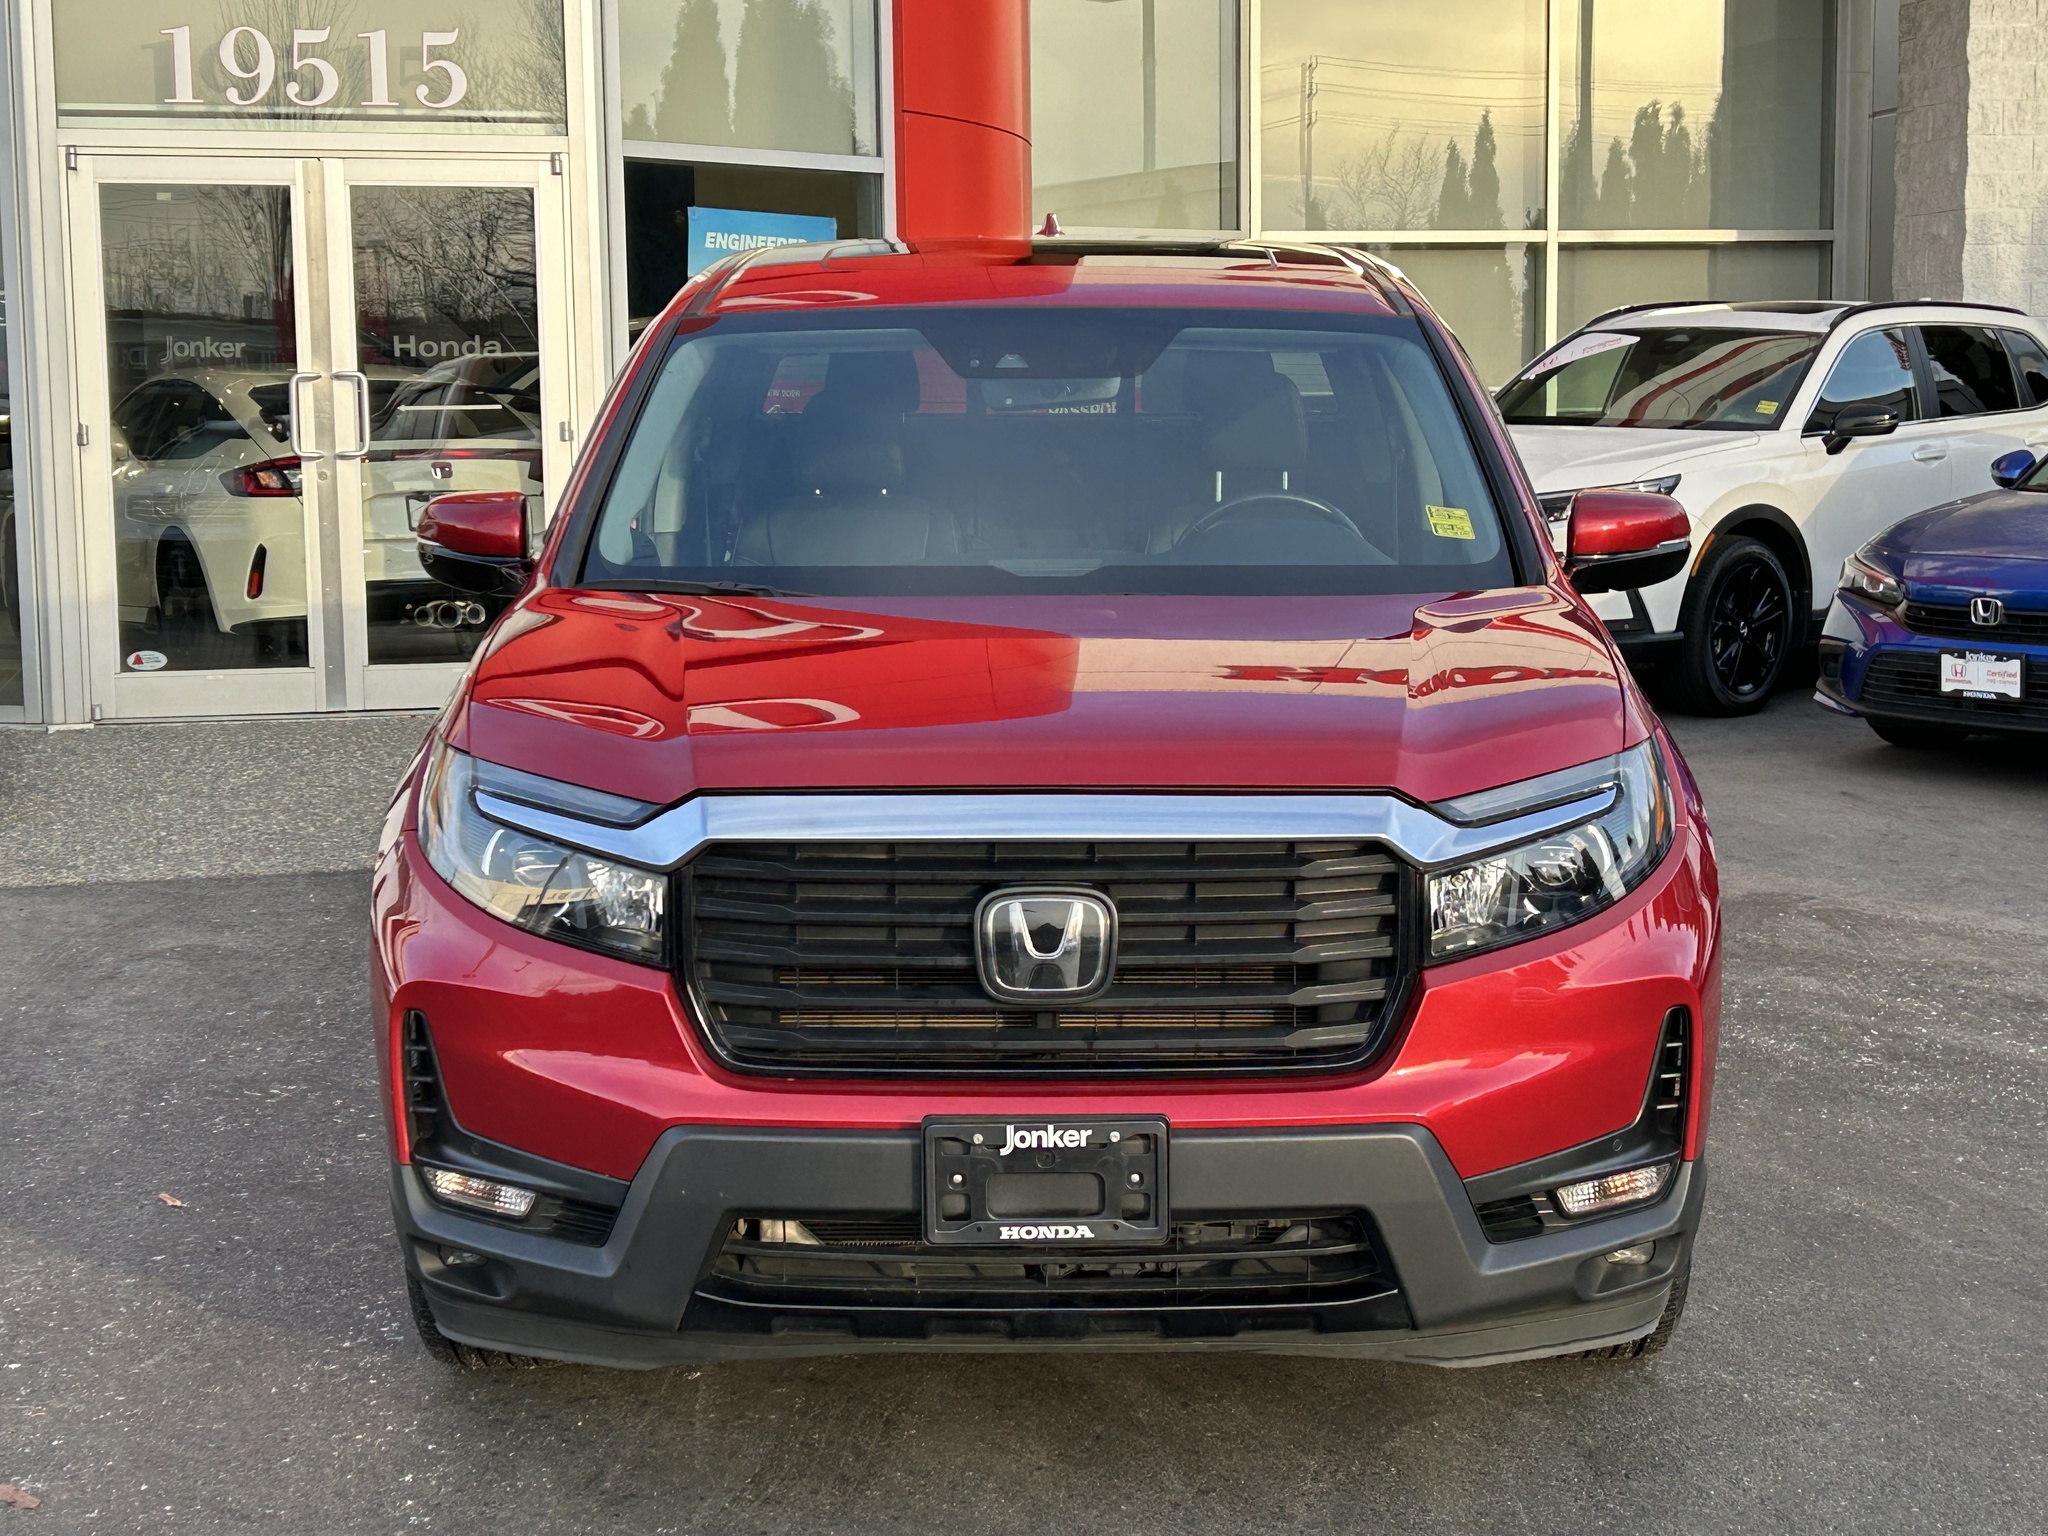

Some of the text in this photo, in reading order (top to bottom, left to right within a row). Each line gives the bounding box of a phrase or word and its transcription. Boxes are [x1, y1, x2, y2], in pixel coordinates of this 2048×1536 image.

[160, 25, 468, 109] 19515
[160, 334, 502, 365] Jonker Honda
[1965, 651, 1997, 662] Jonker
[1986, 669, 2018, 679] Certified
[1963, 691, 1997, 699] HONDA
[1000, 1124, 1093, 1157] Jonker
[999, 1225, 1095, 1240] HONDA
